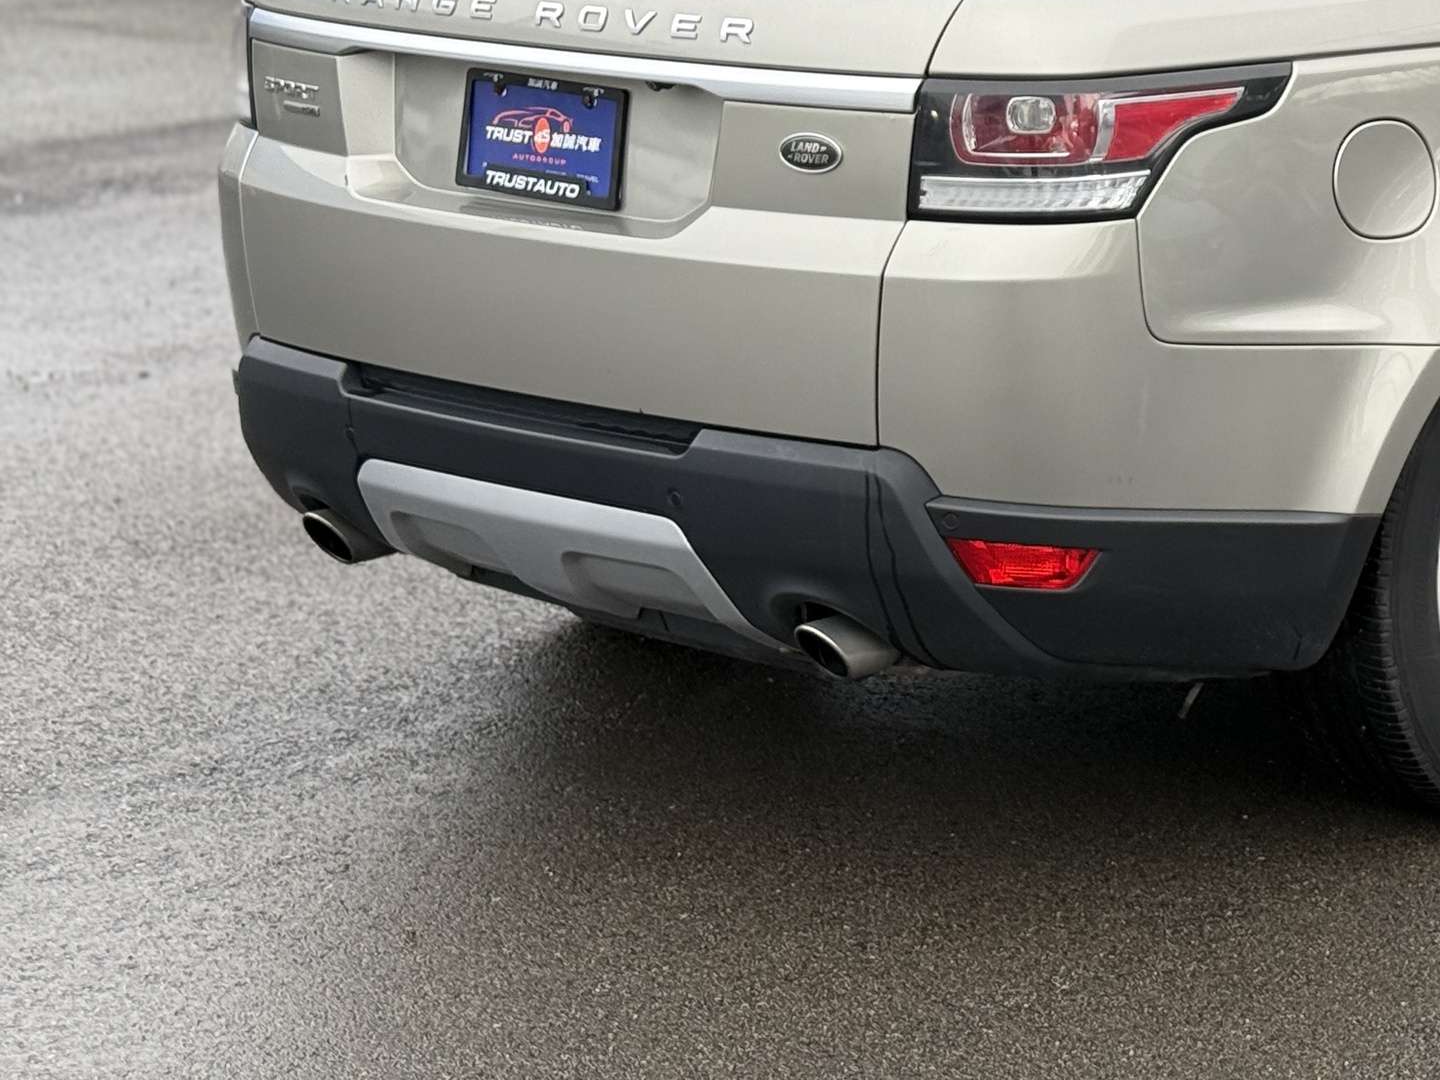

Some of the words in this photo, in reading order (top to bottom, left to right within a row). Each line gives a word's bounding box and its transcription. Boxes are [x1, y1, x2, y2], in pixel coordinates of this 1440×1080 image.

[534, 0, 755, 44] ROVER
[485, 125, 533, 145] TRUST
[790, 140, 820, 153] LAND
[793, 152, 829, 165] ROVER
[485, 169, 580, 199] TRUSTAUTO
